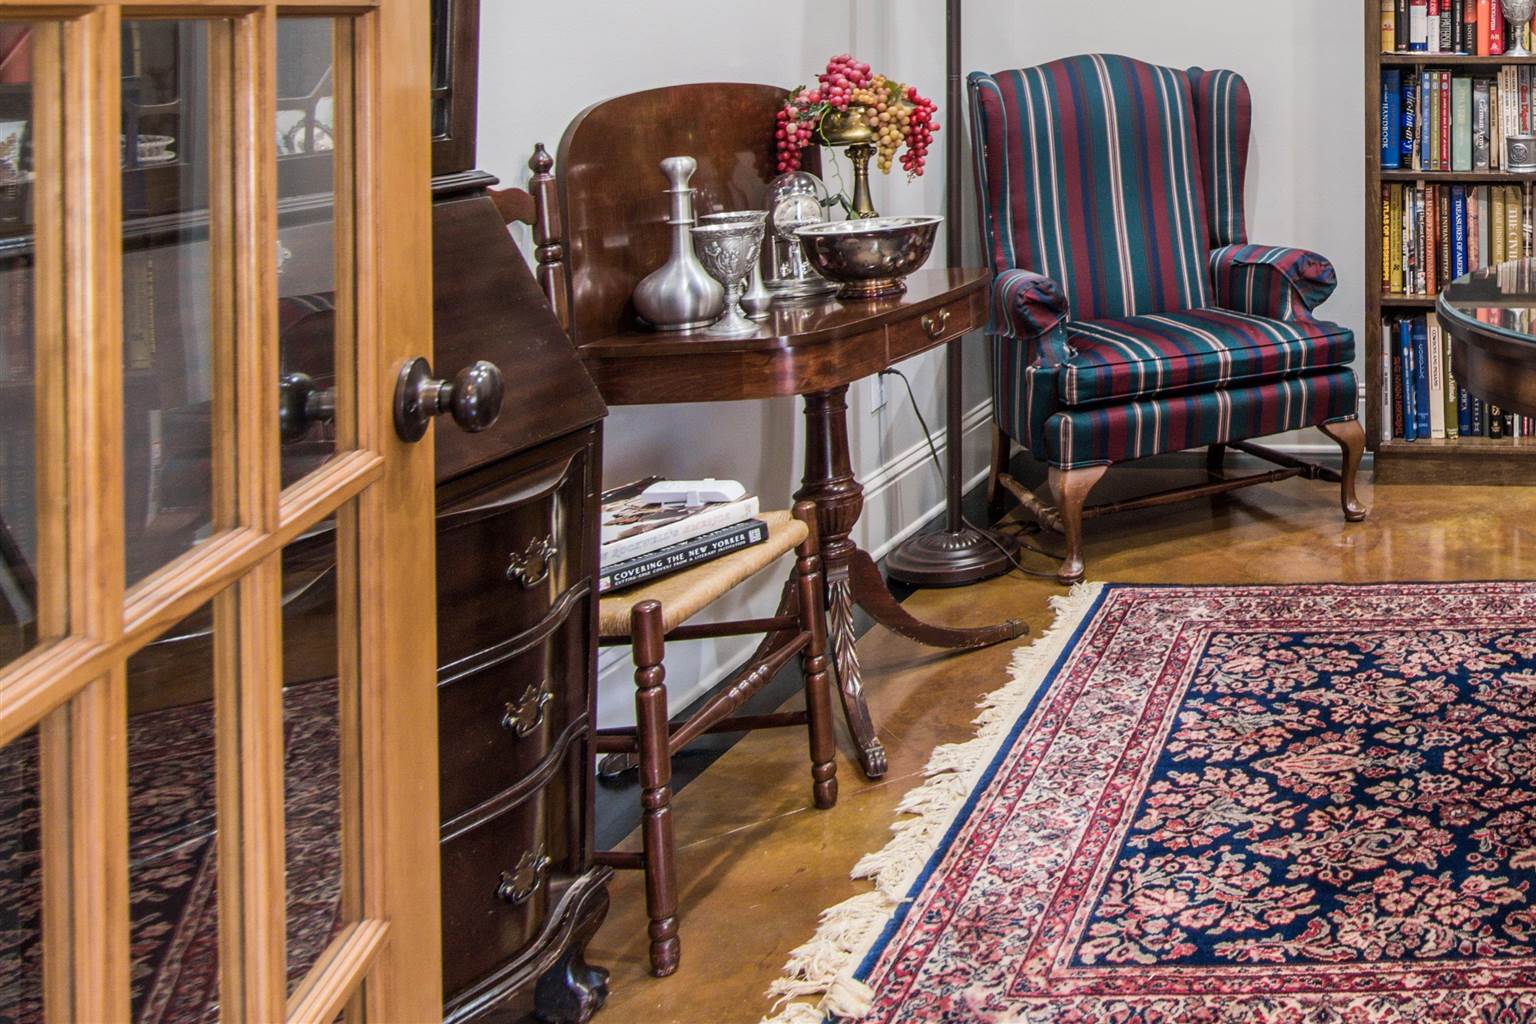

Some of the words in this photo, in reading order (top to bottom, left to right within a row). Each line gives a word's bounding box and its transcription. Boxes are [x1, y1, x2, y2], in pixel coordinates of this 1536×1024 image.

[1440, 18, 1450, 48] PATTERSON
[1383, 225, 1388, 235] OF
[1509, 209, 1517, 230] THE
[614, 560, 662, 581] COVERING
[667, 553, 684, 564] THE
[689, 546, 708, 557] NEW
[712, 534, 745, 548] YORKER
